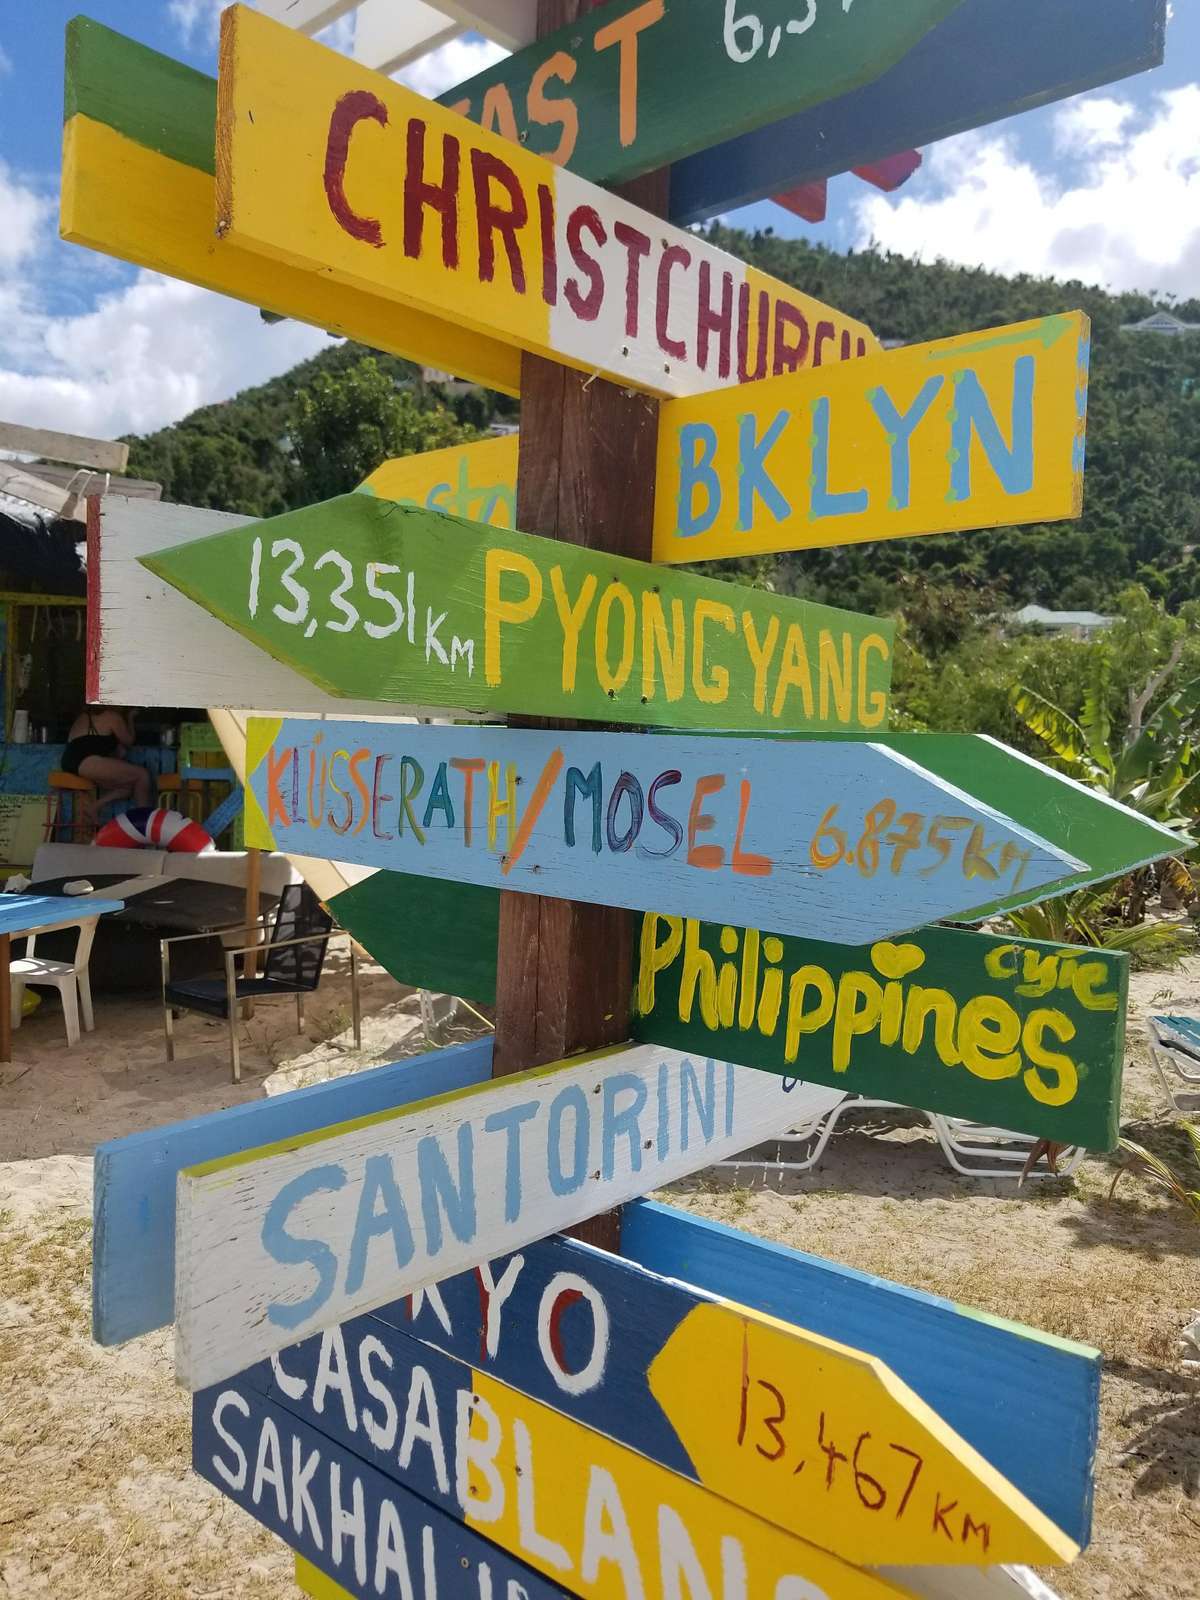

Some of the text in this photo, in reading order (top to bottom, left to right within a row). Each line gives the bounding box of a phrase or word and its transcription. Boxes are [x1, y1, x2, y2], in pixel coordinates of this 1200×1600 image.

[449, 0, 664, 168] AST
[675, 355, 1036, 538] BKLYN
[248, 536, 415, 644] 13,351
[484, 548, 893, 729] PYONGYANG
[810, 797, 975, 879] 6.875
[637, 911, 1079, 1106] Philippines
[261, 1057, 736, 1331] SANTORINI
[211, 1390, 530, 1600] SAKHA
[270, 1324, 833, 1600] CASABLAN
[737, 1318, 924, 1520] 13,467
